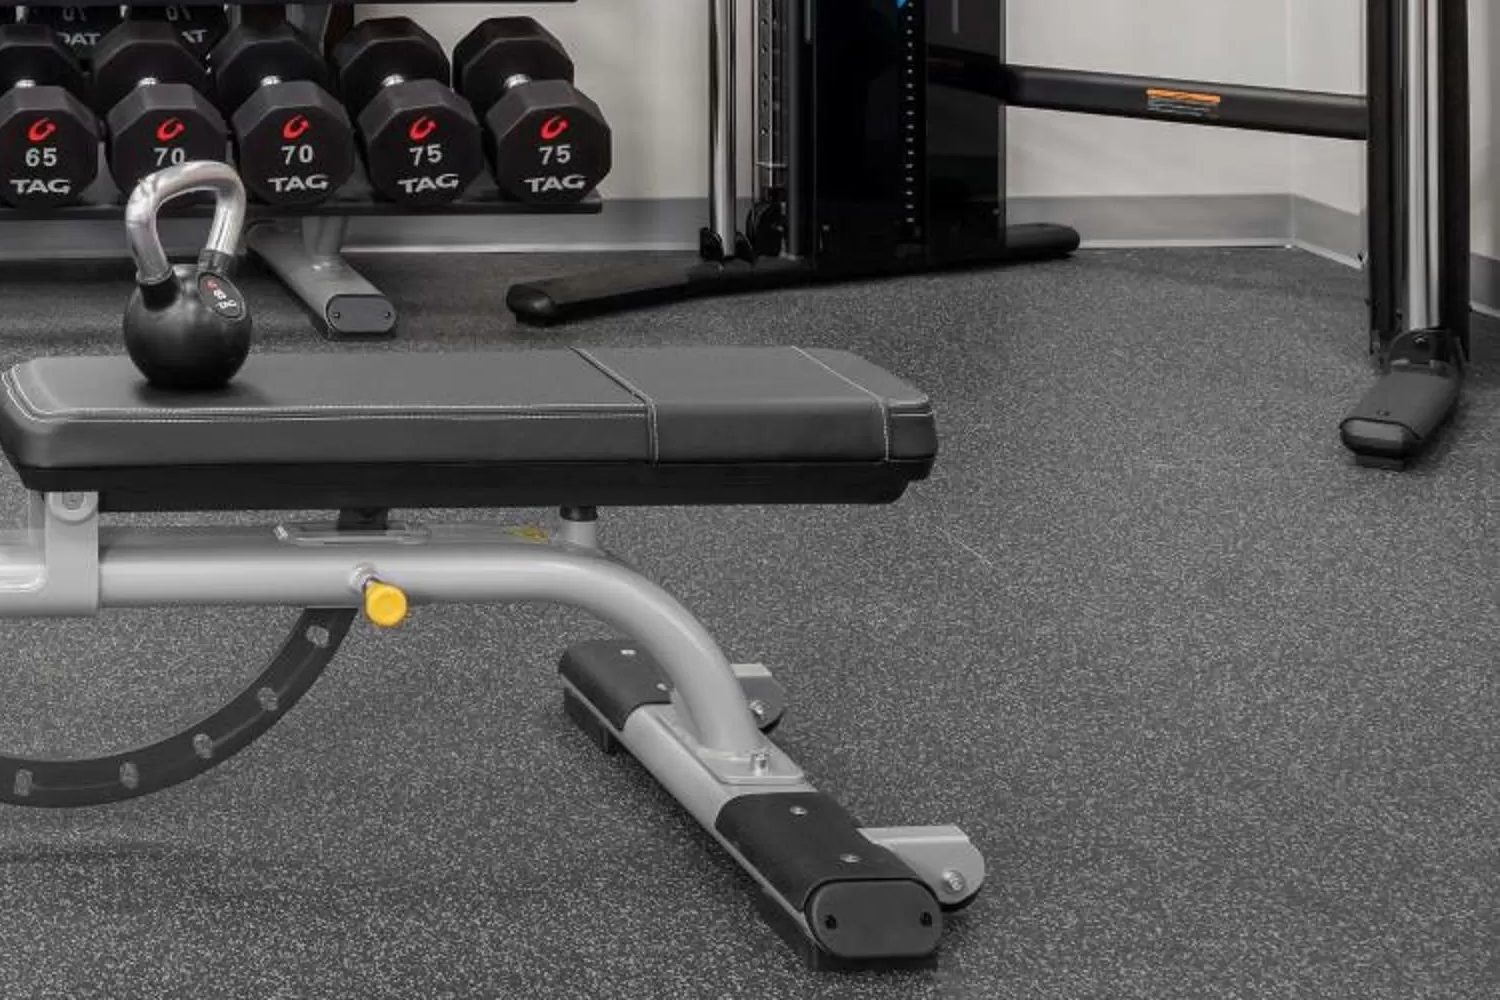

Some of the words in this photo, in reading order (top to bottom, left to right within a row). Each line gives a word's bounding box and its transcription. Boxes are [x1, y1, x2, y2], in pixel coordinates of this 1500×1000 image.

[25, 147, 58, 167] 65
[154, 147, 186, 166] 70
[281, 144, 314, 165] 70
[409, 143, 443, 167] 75
[539, 143, 571, 165] 75
[9, 178, 71, 195] TAG
[267, 174, 329, 193] TAG
[397, 173, 459, 194] TAG
[523, 174, 585, 192] TAG
